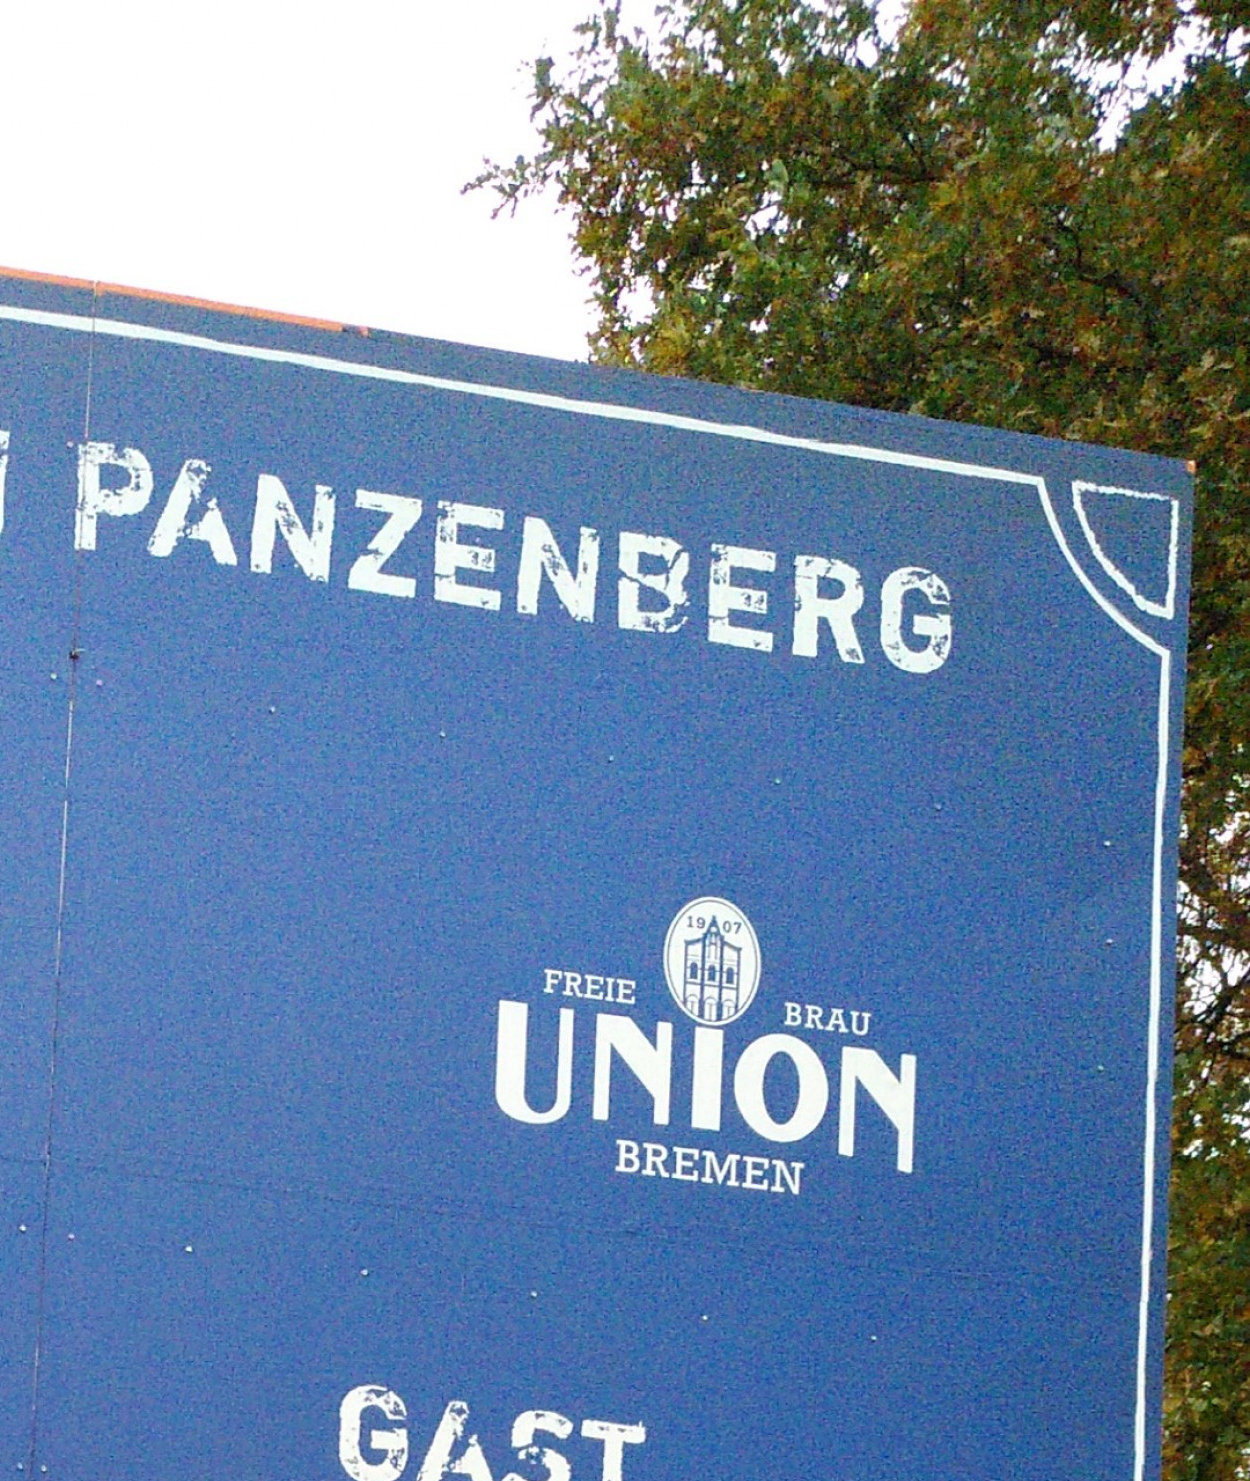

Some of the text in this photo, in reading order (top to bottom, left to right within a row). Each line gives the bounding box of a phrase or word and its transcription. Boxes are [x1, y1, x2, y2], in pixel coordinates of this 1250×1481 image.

[75, 440, 952, 674] PANZENBERG
[543, 968, 636, 1005] FREIE
[783, 1002, 871, 1037] BRAU
[495, 999, 917, 1173] UNION
[615, 1139, 805, 1195] BREMEN
